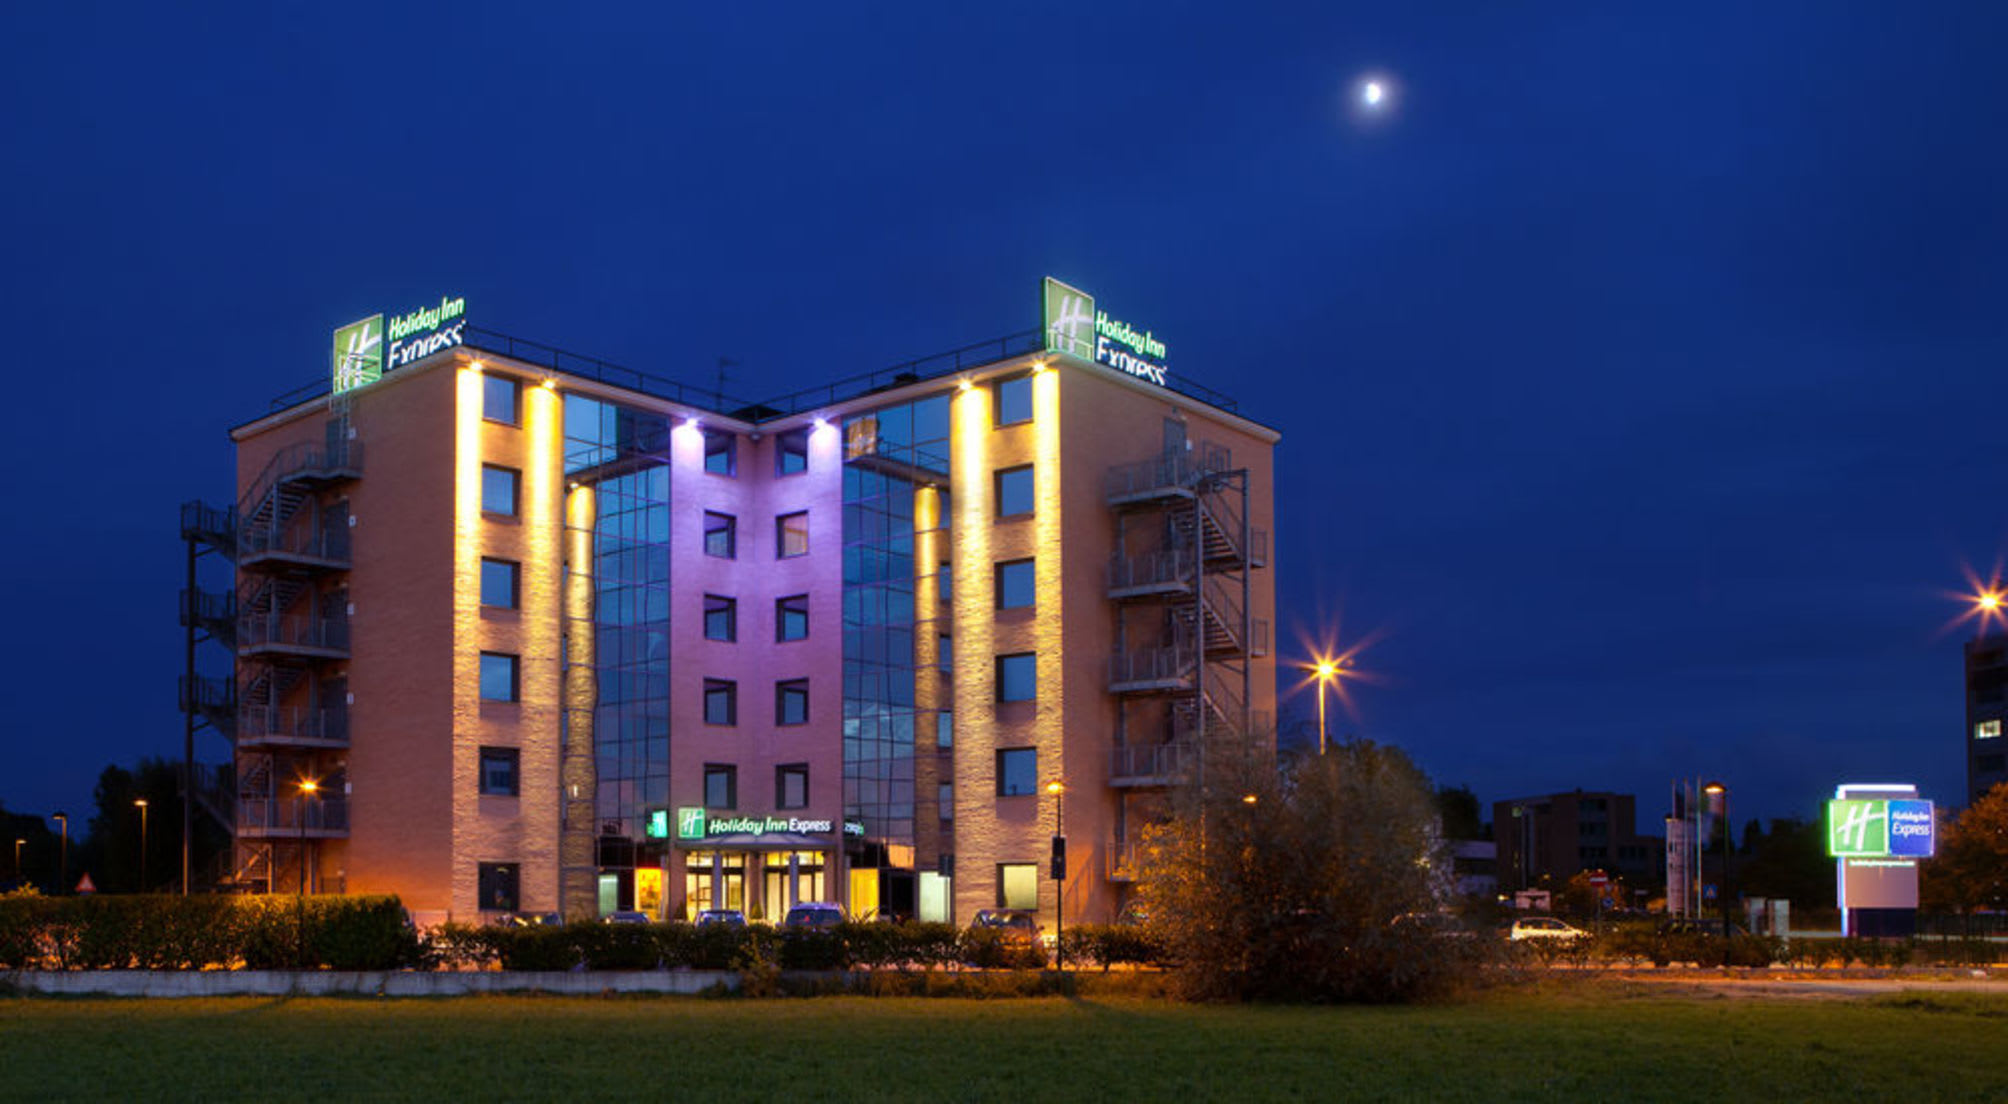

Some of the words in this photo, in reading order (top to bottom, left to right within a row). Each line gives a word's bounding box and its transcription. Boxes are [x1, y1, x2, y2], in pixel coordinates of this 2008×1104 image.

[388, 306, 440, 341] Holiday
[441, 296, 464, 321] Inn
[1095, 309, 1145, 355] Holiday
[1146, 330, 1165, 360] Inn
[709, 817, 764, 836] Holiday
[765, 816, 788, 832] Inn
[788, 818, 832, 835] Express
[1892, 822, 1930, 838] Express
